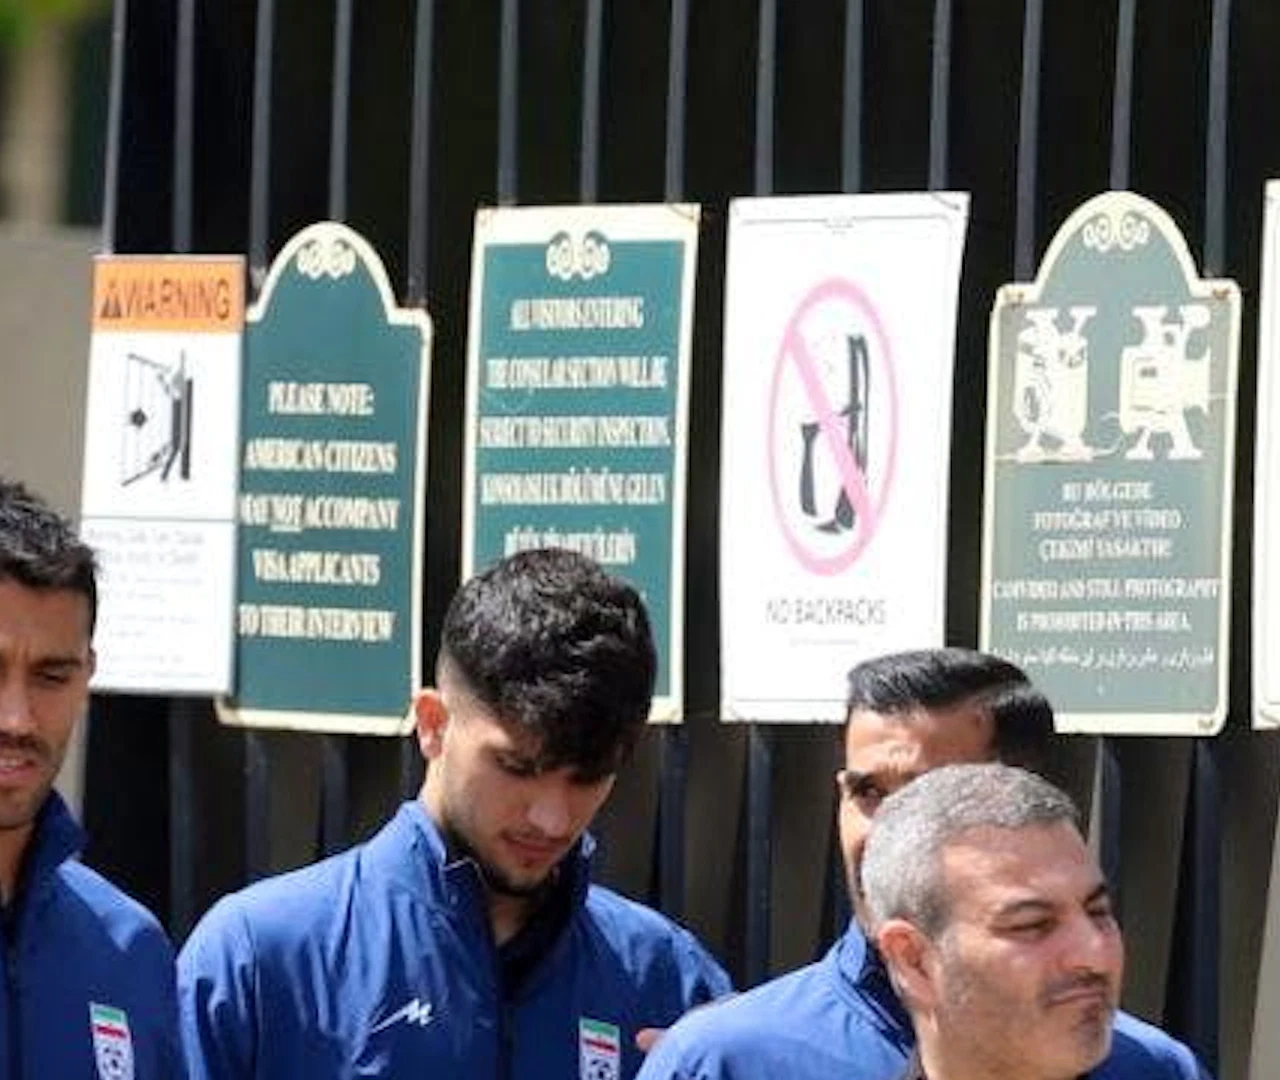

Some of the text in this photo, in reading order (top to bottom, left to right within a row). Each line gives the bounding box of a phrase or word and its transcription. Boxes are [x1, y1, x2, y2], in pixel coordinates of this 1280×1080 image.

[123, 279, 230, 321] WARNING
[268, 380, 375, 417] PLEASE NOTE:
[244, 436, 398, 474] AMERICAN CITIZENS
[270, 493, 303, 530] NOT
[303, 495, 401, 531] ACCOMPANY
[252, 548, 381, 586] VISA APPLICANTS
[239, 603, 260, 636] TO
[766, 597, 886, 626] NO BACKPACKS
